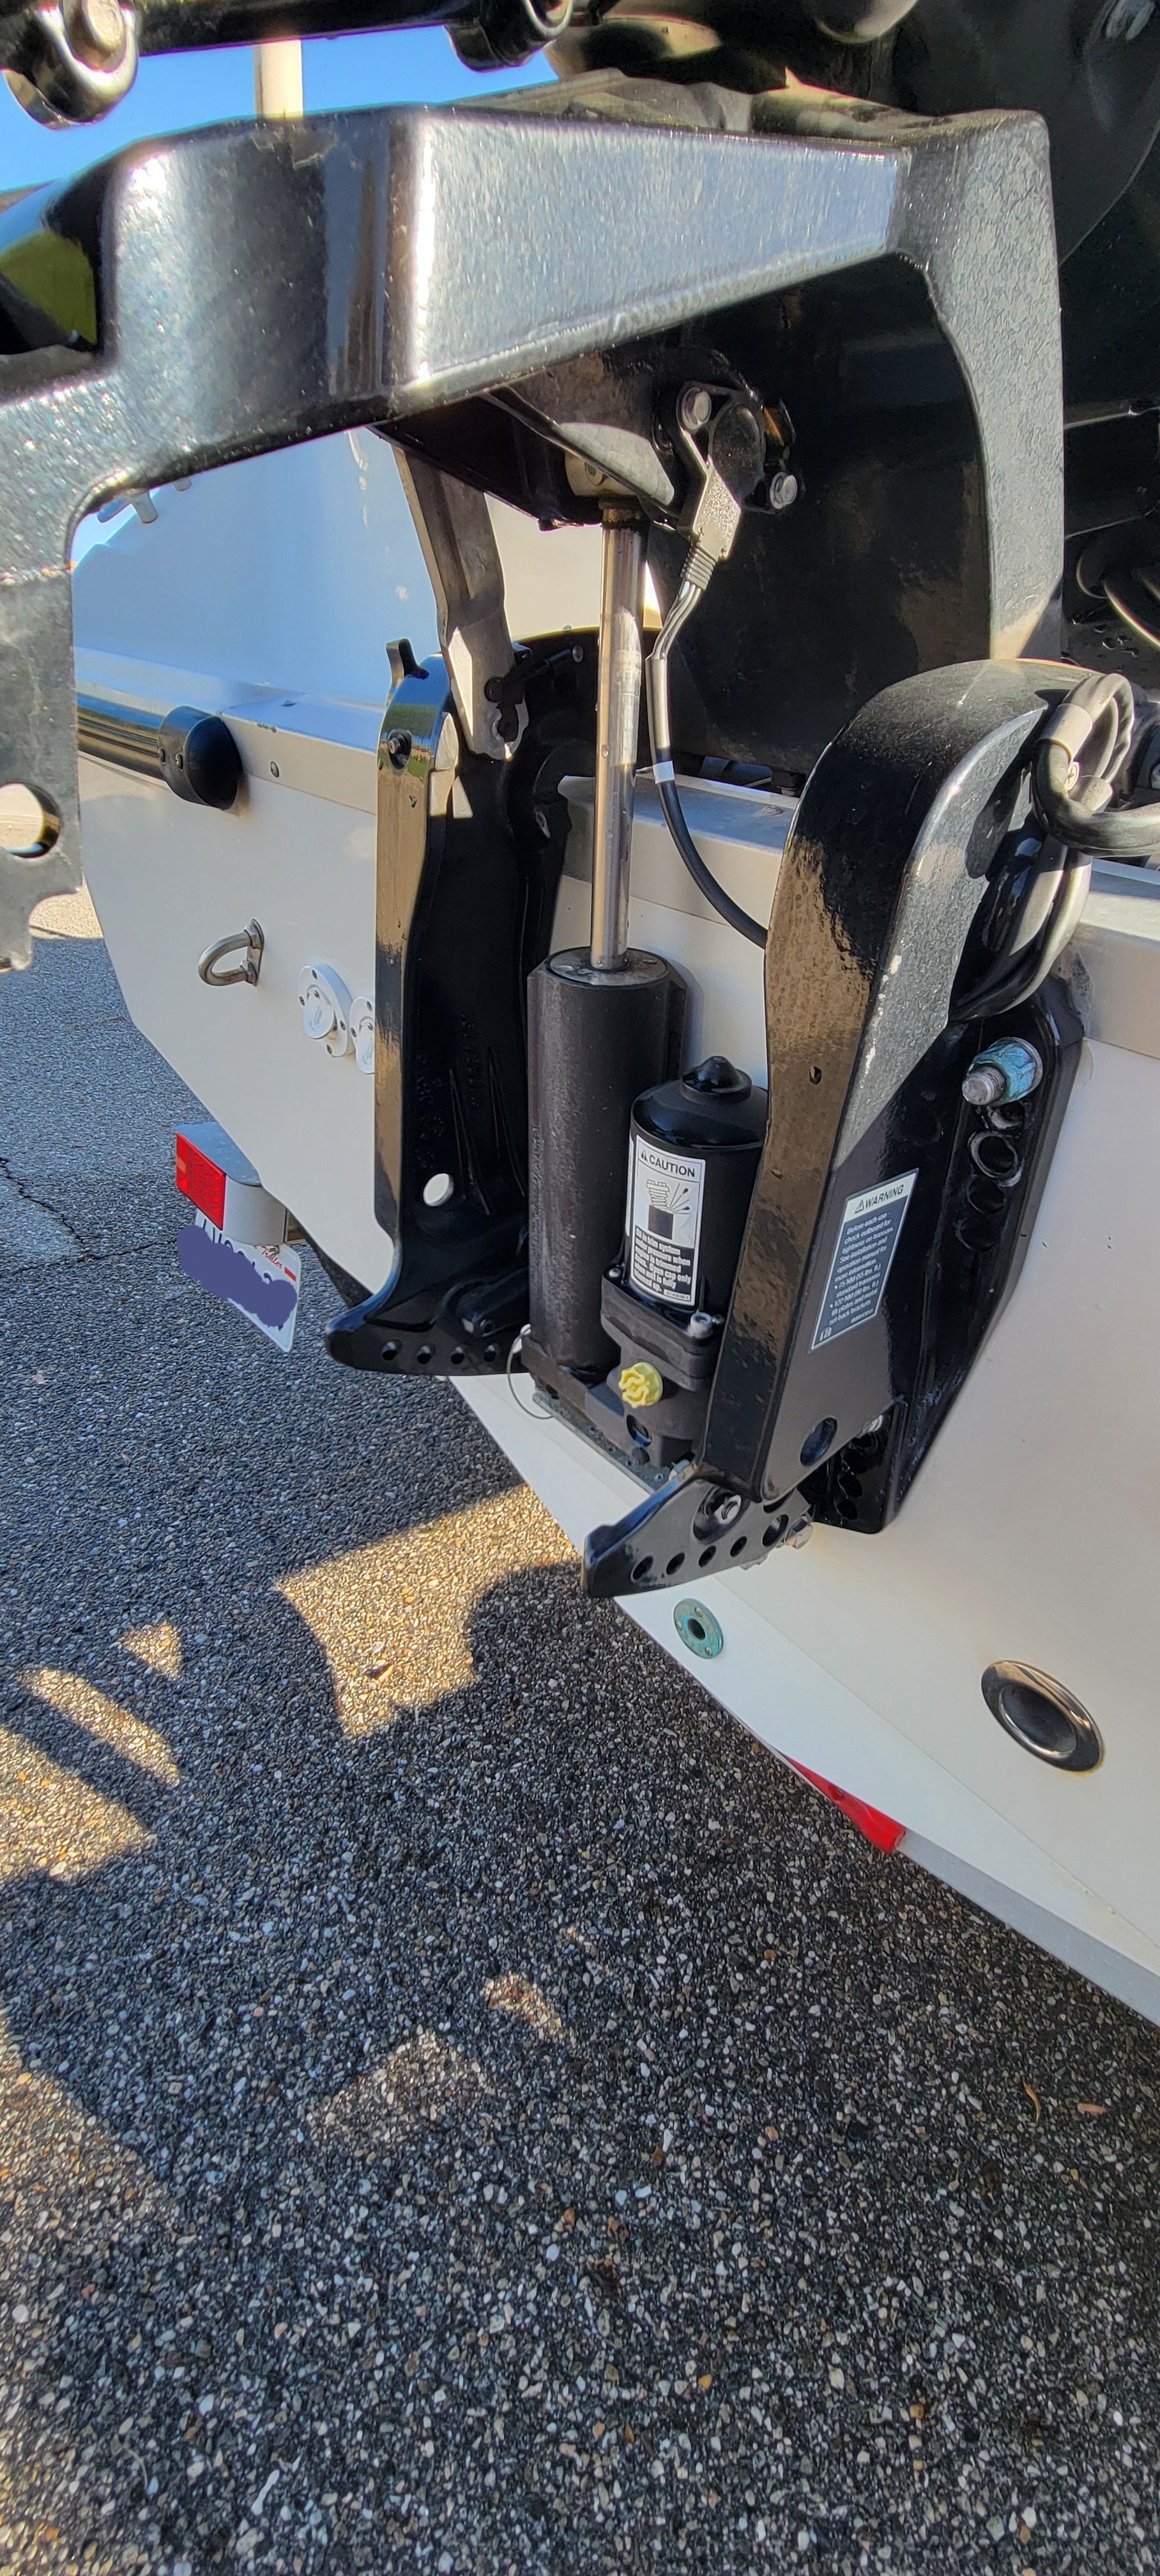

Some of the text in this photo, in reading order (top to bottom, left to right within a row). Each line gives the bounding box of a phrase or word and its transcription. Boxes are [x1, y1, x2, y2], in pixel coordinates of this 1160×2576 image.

[649, 1154, 696, 1177] CAUTION
[865, 1184, 904, 1208] WARNING
[648, 1236, 658, 1248] trim
[659, 1243, 680, 1255] system
[648, 1246, 671, 1261] pressure
[673, 1256, 691, 1266] when
[656, 1258, 681, 1273] trimmed
[650, 1263, 664, 1276] Open
[665, 1271, 676, 1281] cap
[677, 1275, 691, 1284] only
[663, 1277, 676, 1289] fully
